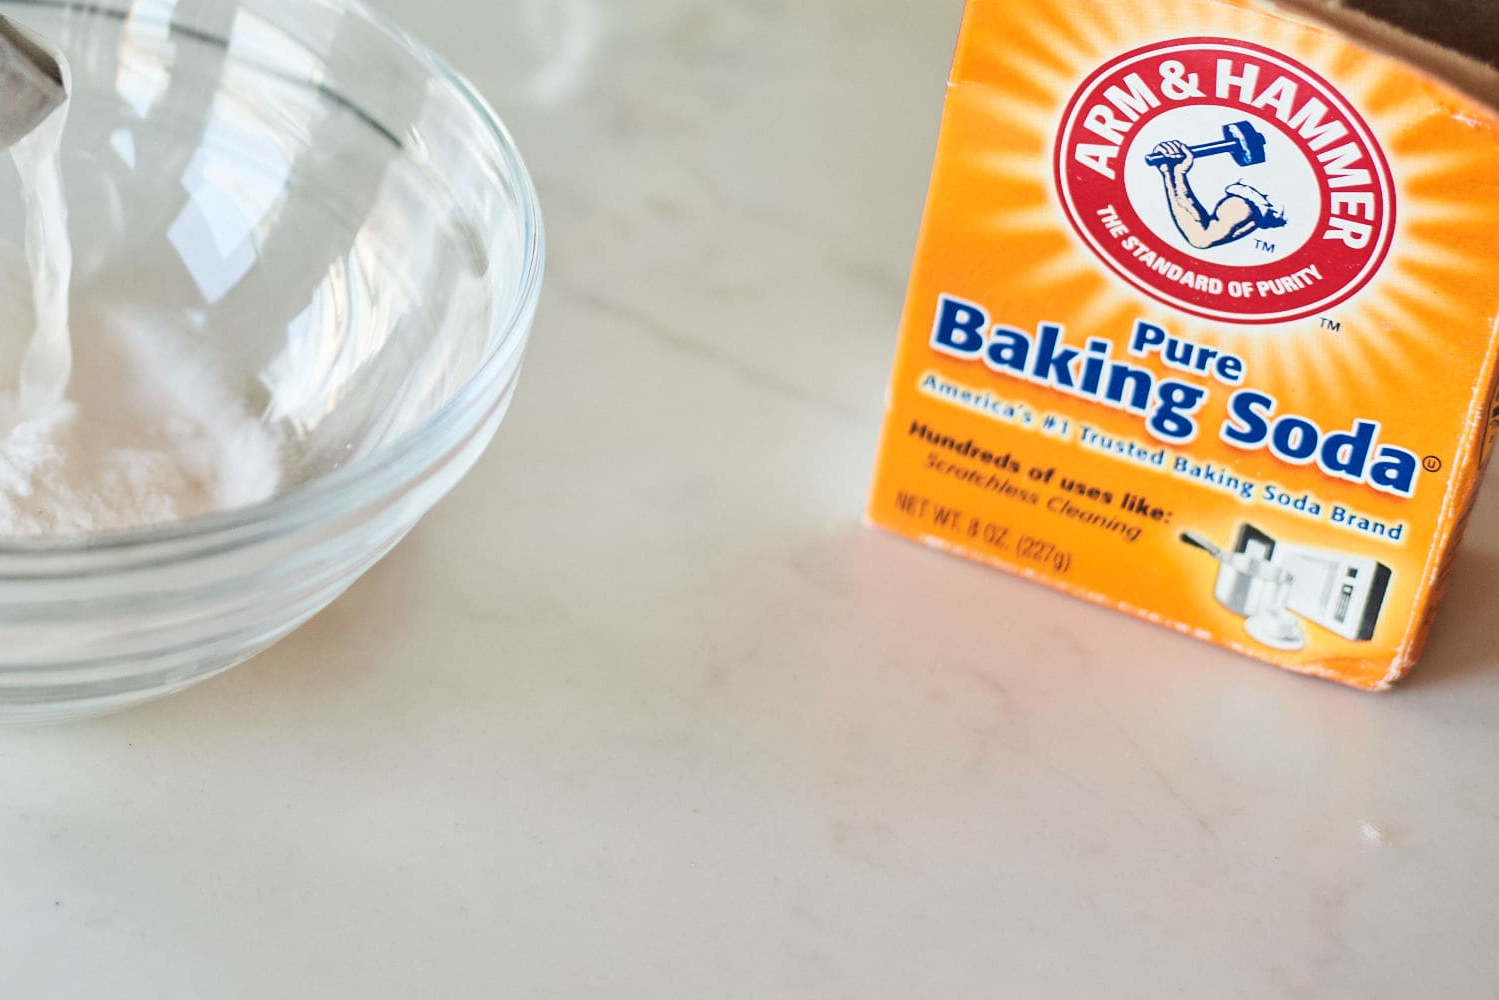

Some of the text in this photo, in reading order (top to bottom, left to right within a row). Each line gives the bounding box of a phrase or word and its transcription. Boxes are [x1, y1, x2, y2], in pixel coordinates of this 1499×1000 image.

[1074, 57, 1376, 251] ARM & HAMMER
[1095, 203, 1325, 299] THE STANDARD OF PURITY
[1253, 237, 1276, 254] TM
[1130, 318, 1245, 383] Pure
[1318, 316, 1342, 333] TM
[933, 297, 1419, 495] Baking Soda
[908, 420, 1173, 524] Hundreds of uses like:
[920, 372, 1404, 541] America's #1 Trusted Baking Soda Brand
[925, 452, 1143, 542] Scratchless Cleaning
[894, 490, 1072, 574] NET WT. 8 OZ. (227g)
